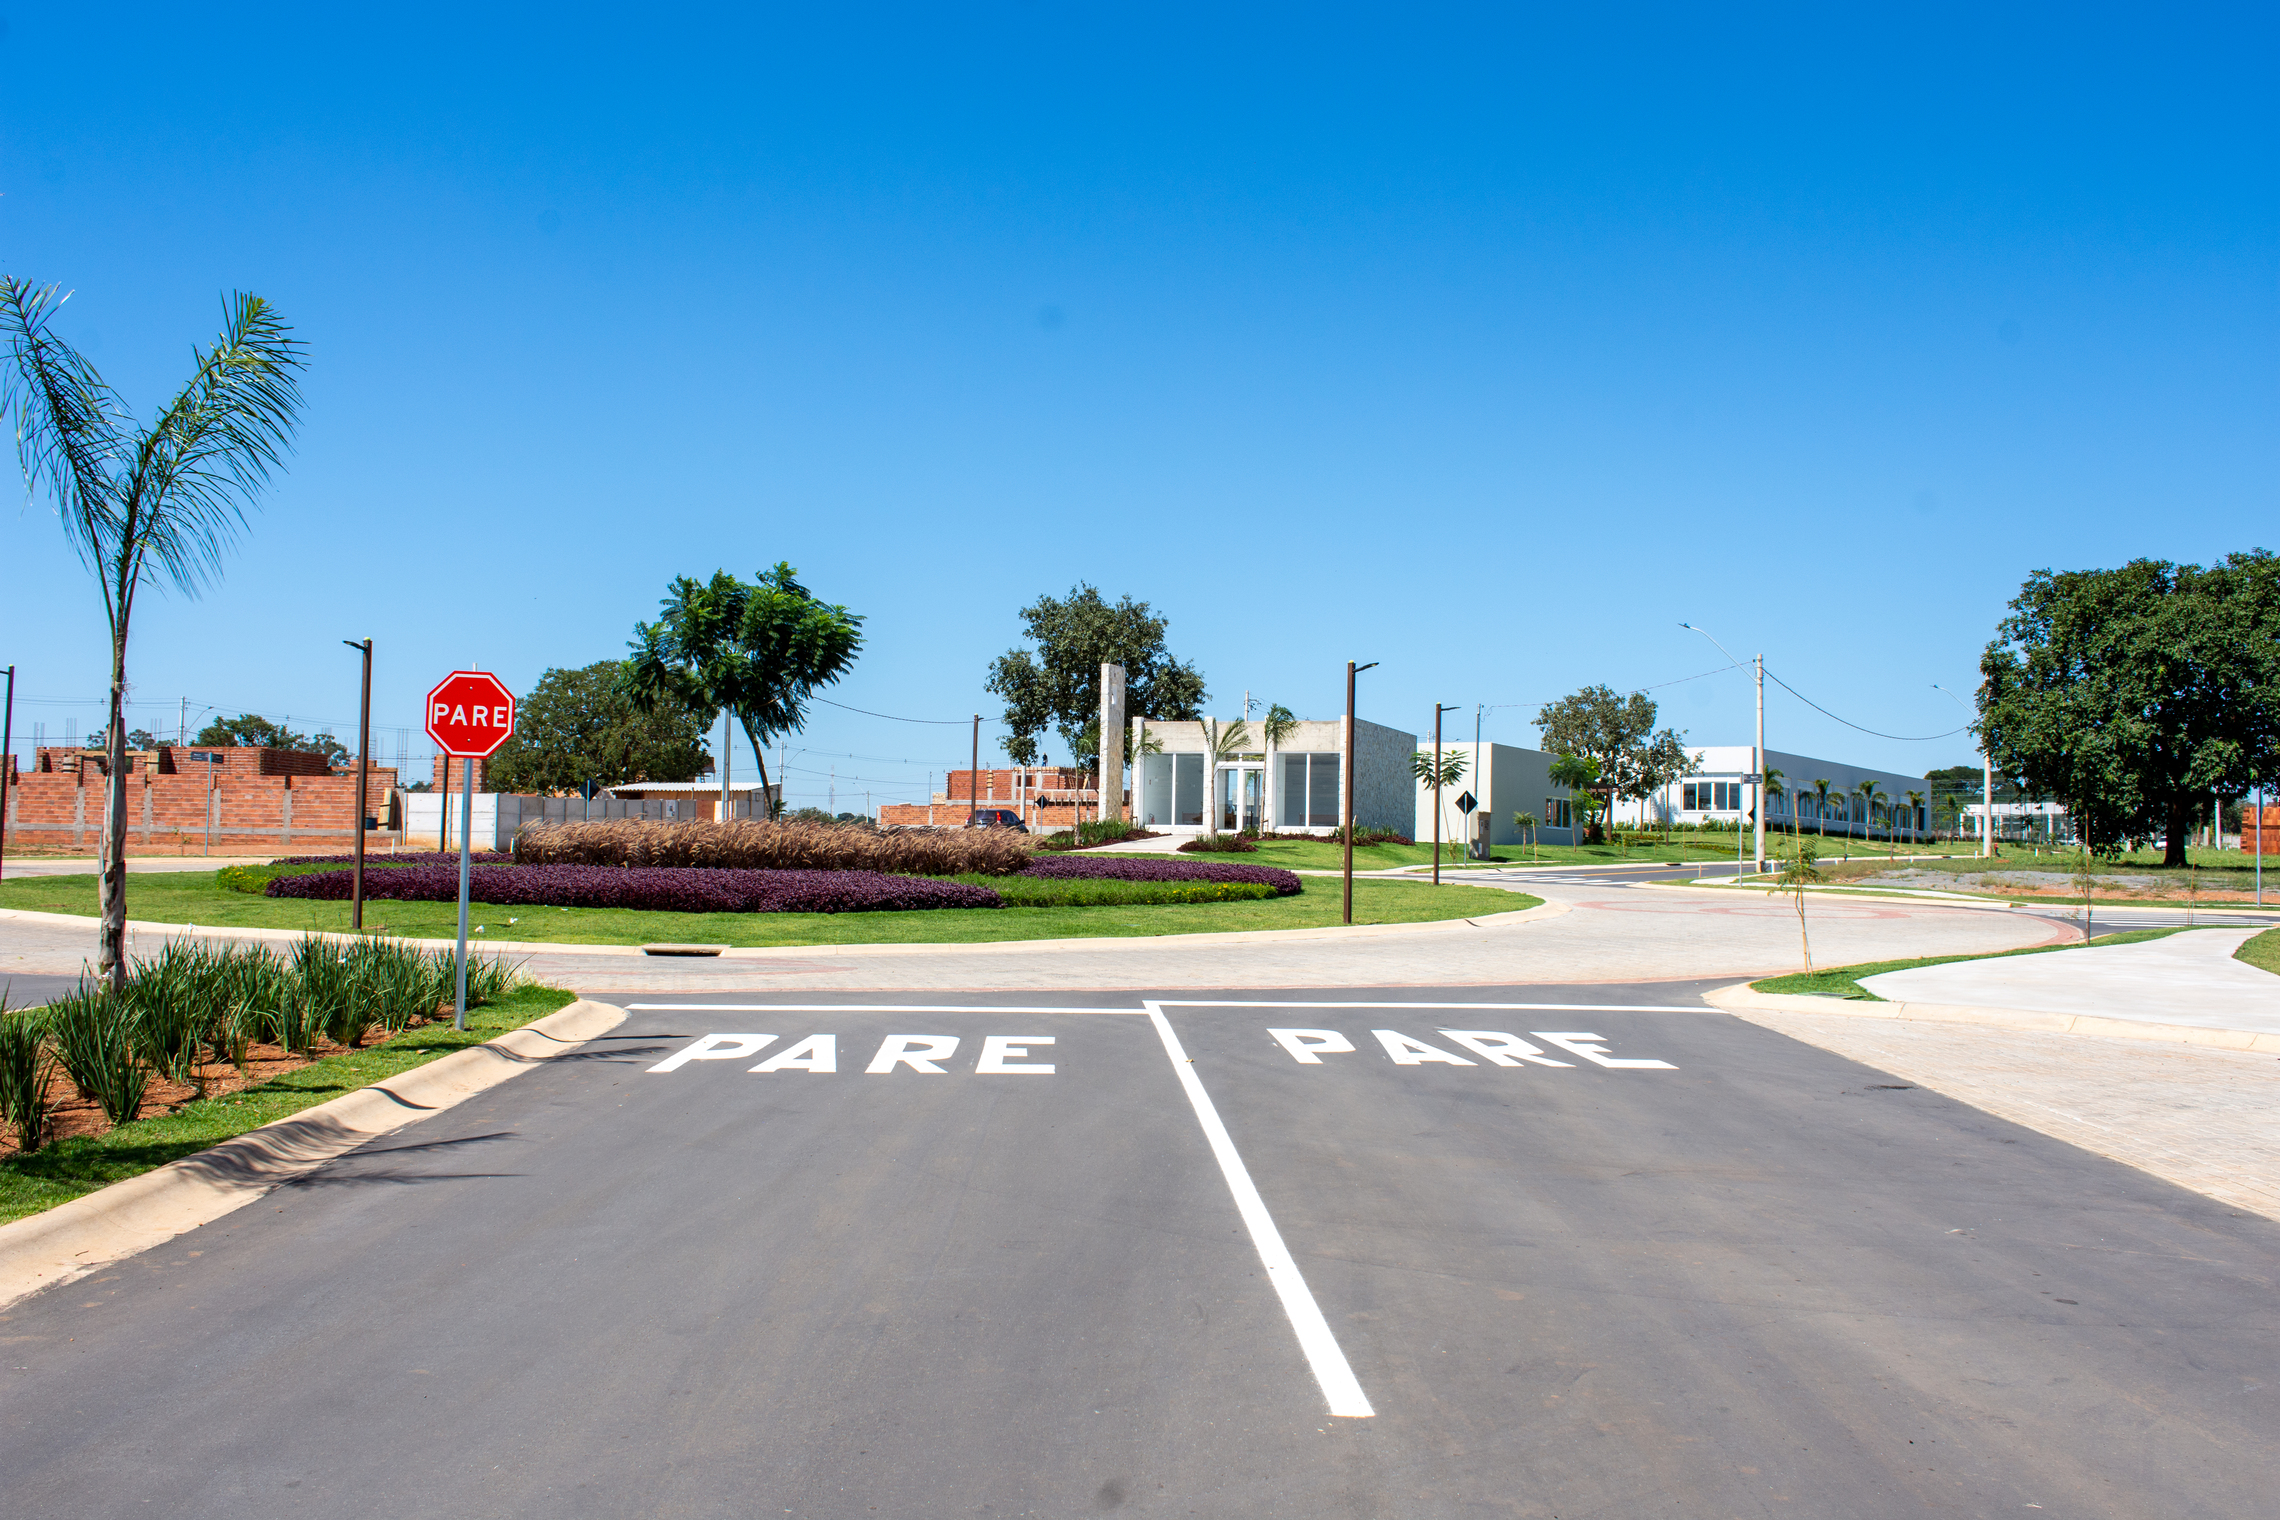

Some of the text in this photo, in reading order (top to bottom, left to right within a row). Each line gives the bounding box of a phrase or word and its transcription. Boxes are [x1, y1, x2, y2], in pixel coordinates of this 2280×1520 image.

[433, 703, 507, 728] PARE
[645, 1033, 1056, 1074] PARE
[1266, 1028, 1680, 1069] PARE
